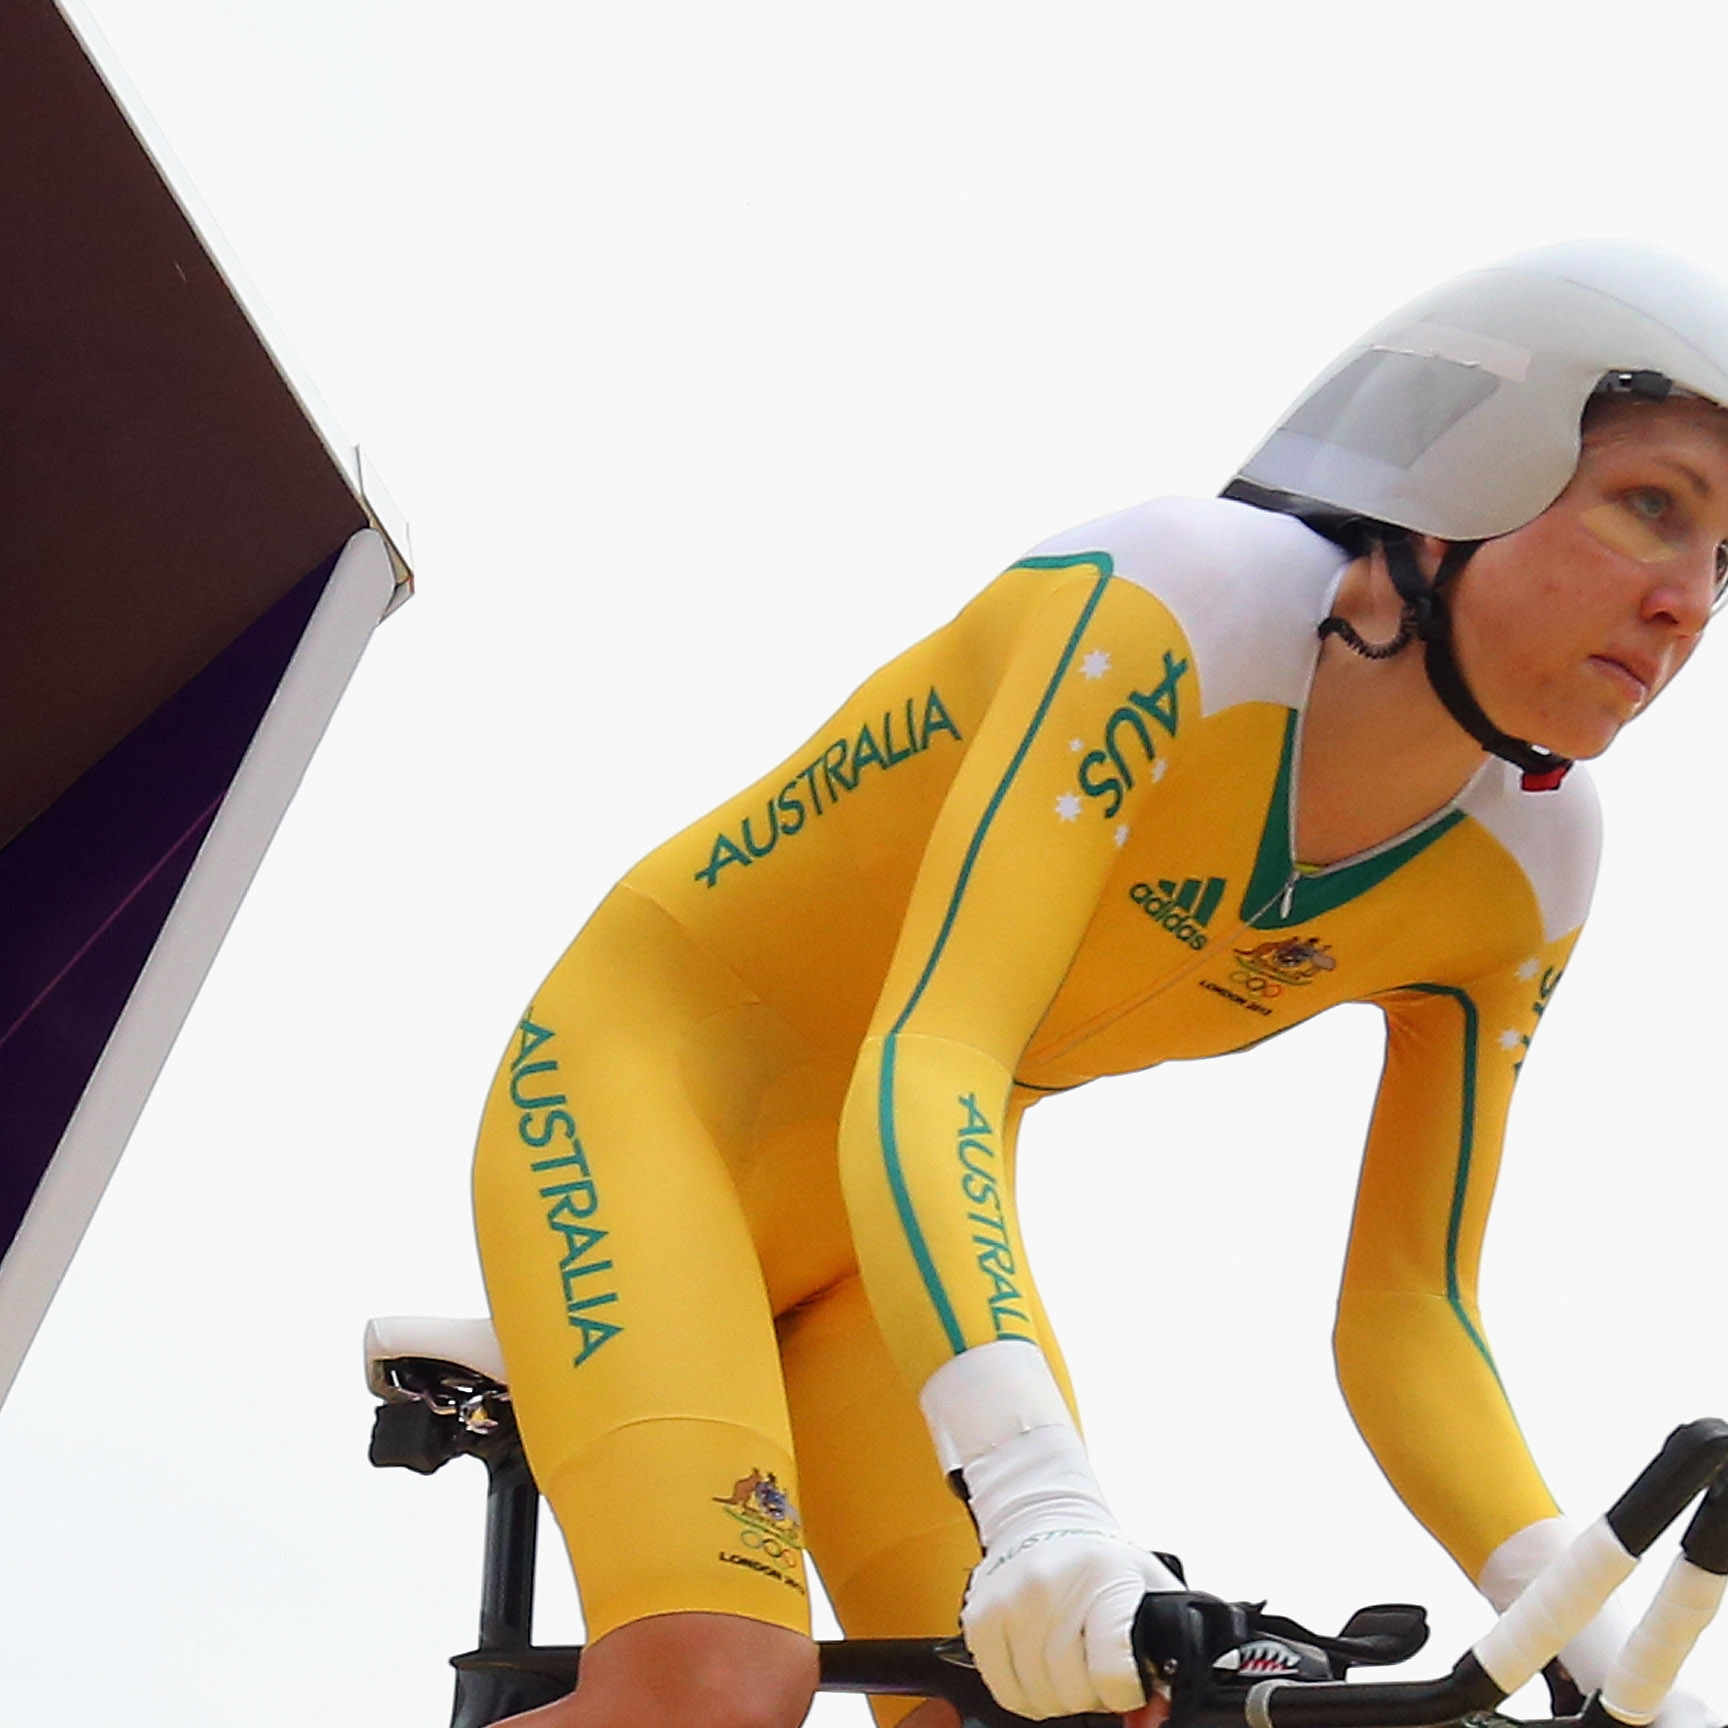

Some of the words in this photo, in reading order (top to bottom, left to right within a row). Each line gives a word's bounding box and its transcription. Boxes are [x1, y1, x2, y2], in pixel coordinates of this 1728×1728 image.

[694, 685, 963, 889] AUSTRALIA
[1078, 648, 1189, 820] AUS
[1129, 882, 1208, 951] adidas
[509, 1005, 625, 1369] AUSTRALIA
